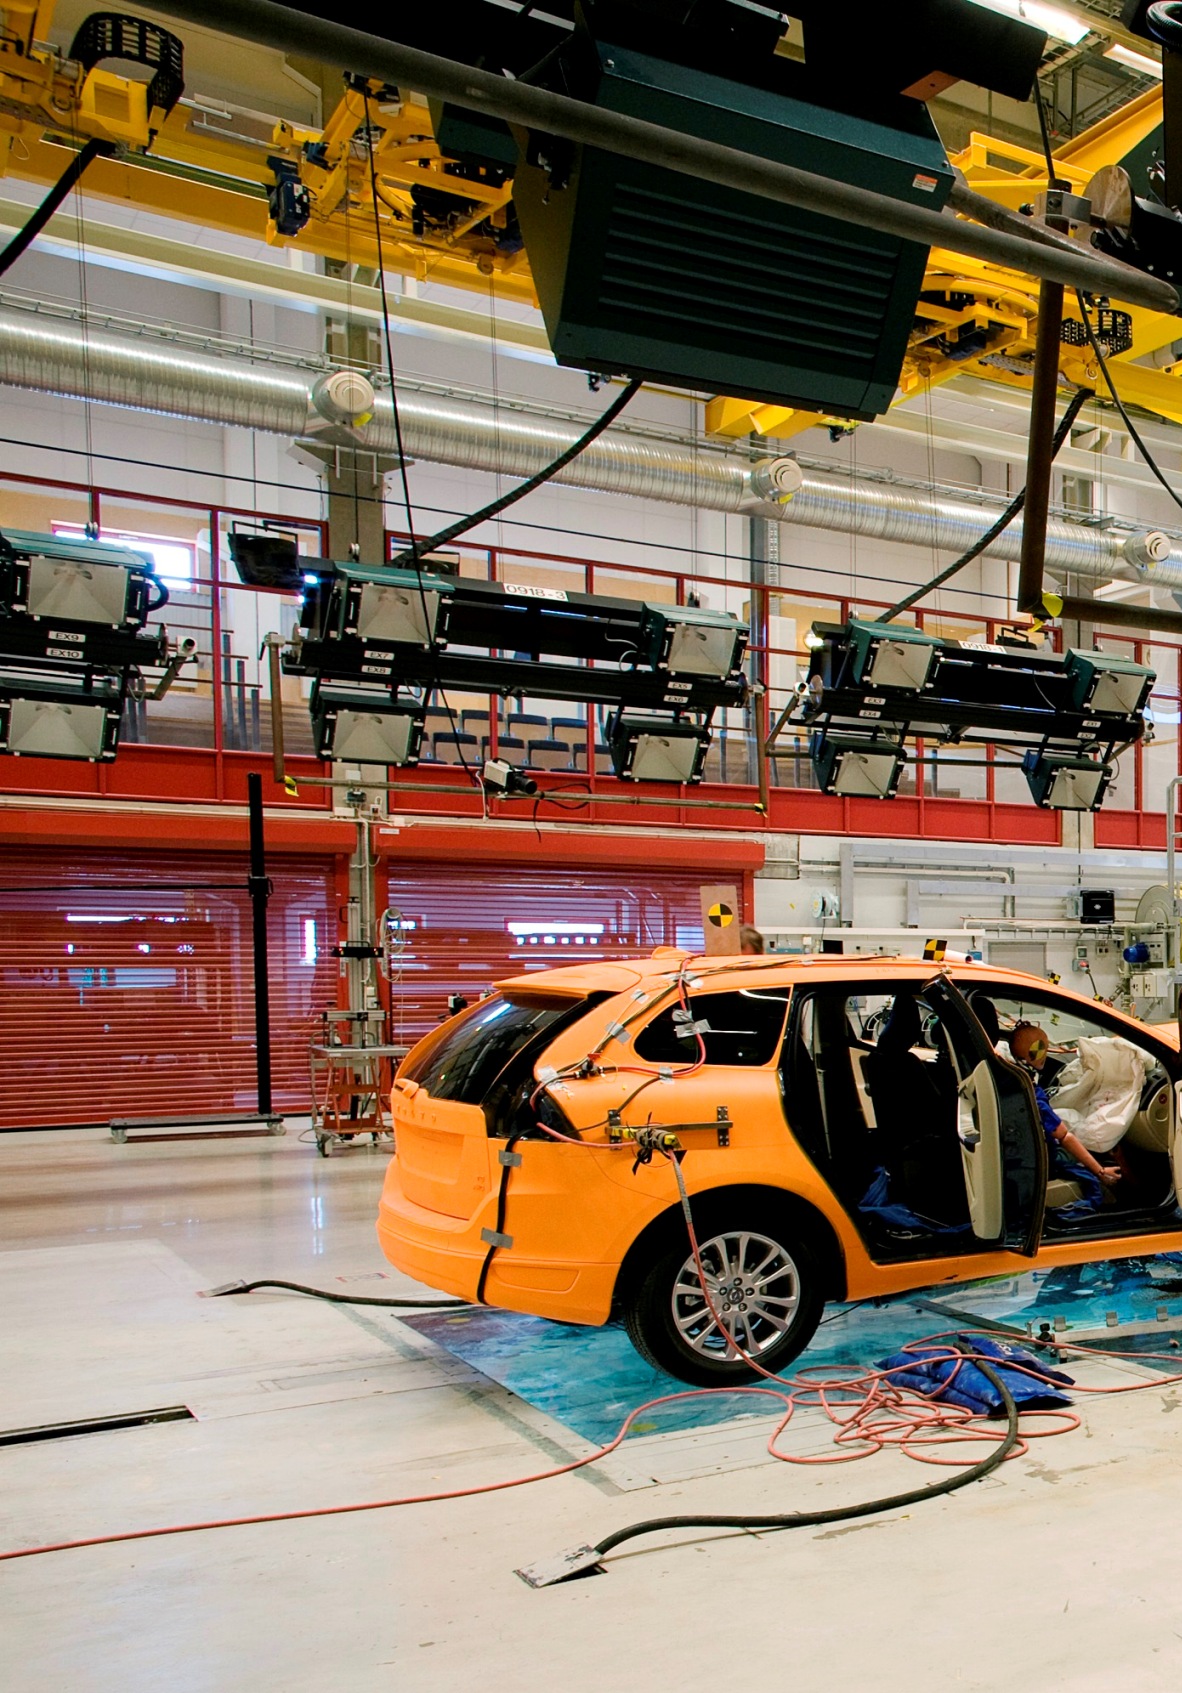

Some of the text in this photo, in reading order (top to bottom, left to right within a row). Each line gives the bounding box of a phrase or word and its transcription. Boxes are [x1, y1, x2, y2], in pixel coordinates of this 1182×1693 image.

[506, 585, 566, 600] 0918-3
[56, 633, 79, 641] EX9
[51, 649, 80, 658] EX10
[370, 651, 389, 659] EX7
